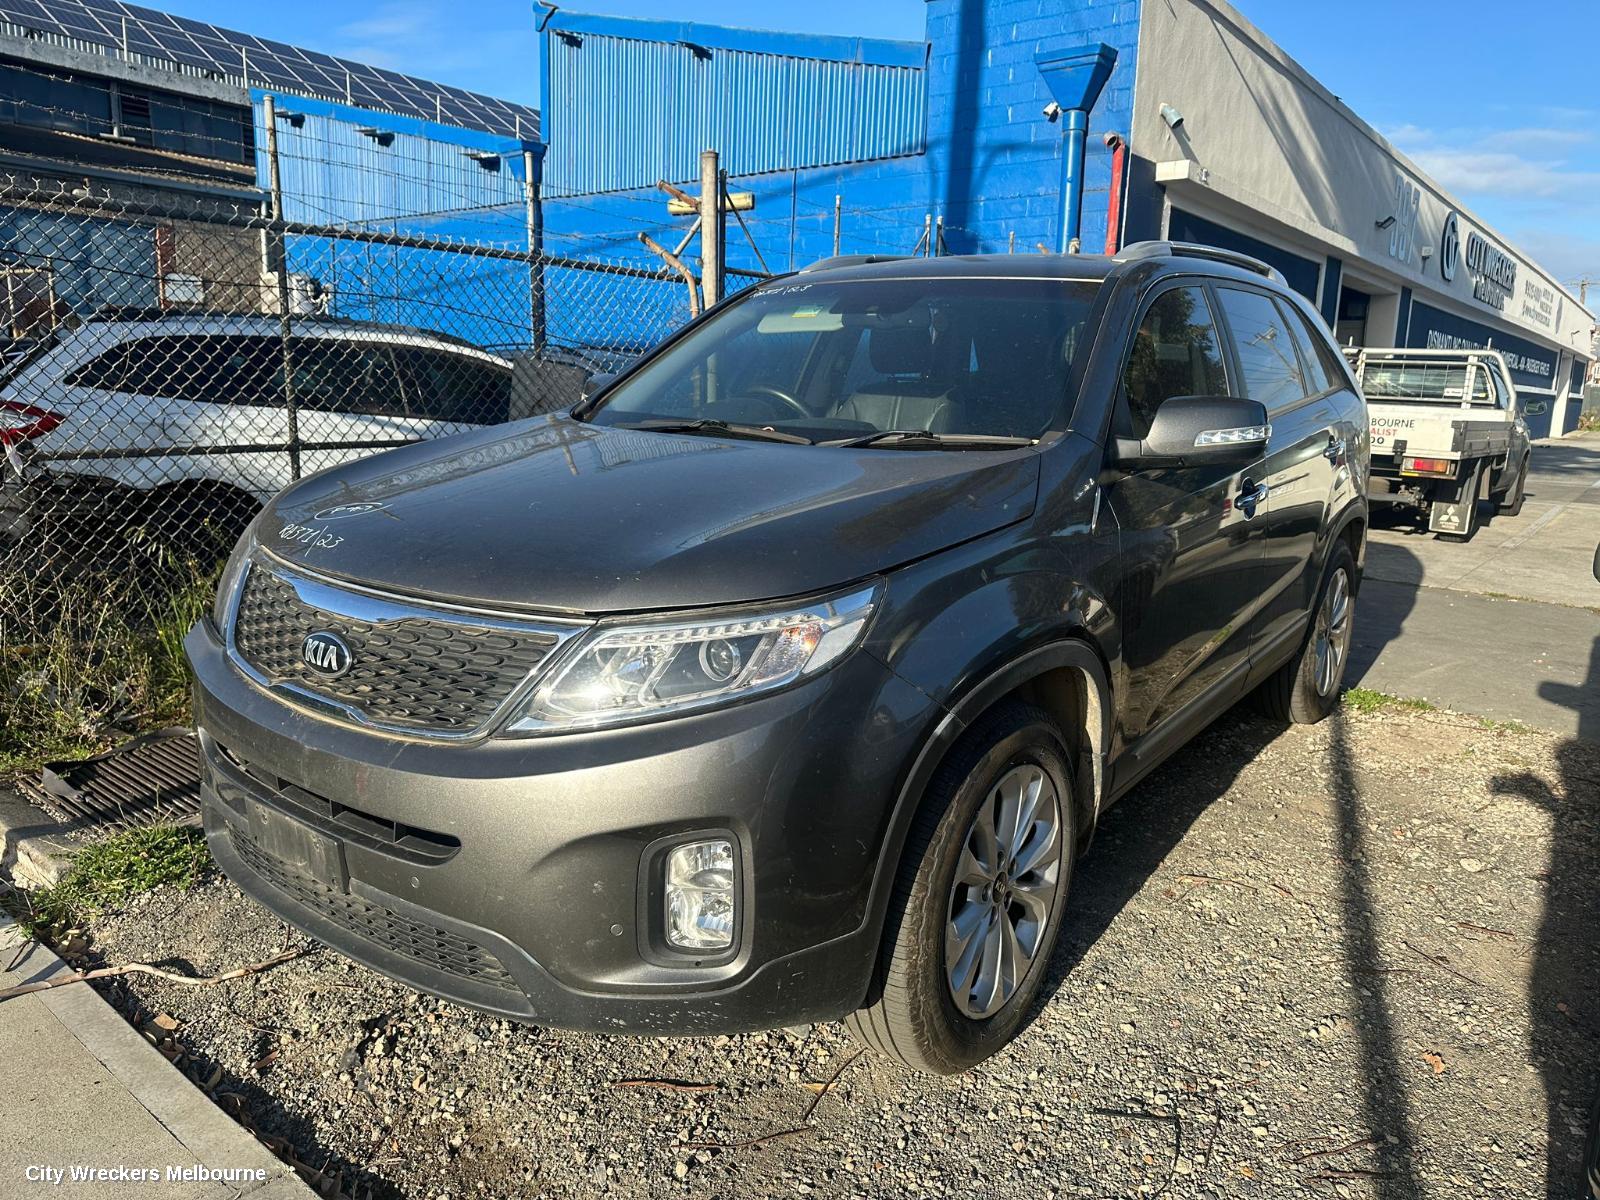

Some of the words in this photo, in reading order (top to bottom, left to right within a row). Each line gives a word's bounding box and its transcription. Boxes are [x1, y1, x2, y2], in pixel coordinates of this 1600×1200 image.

[1371, 418, 1415, 428] BOURNE
[1370, 428, 1398, 437] ALIST
[305, 638, 338, 671] KIA
